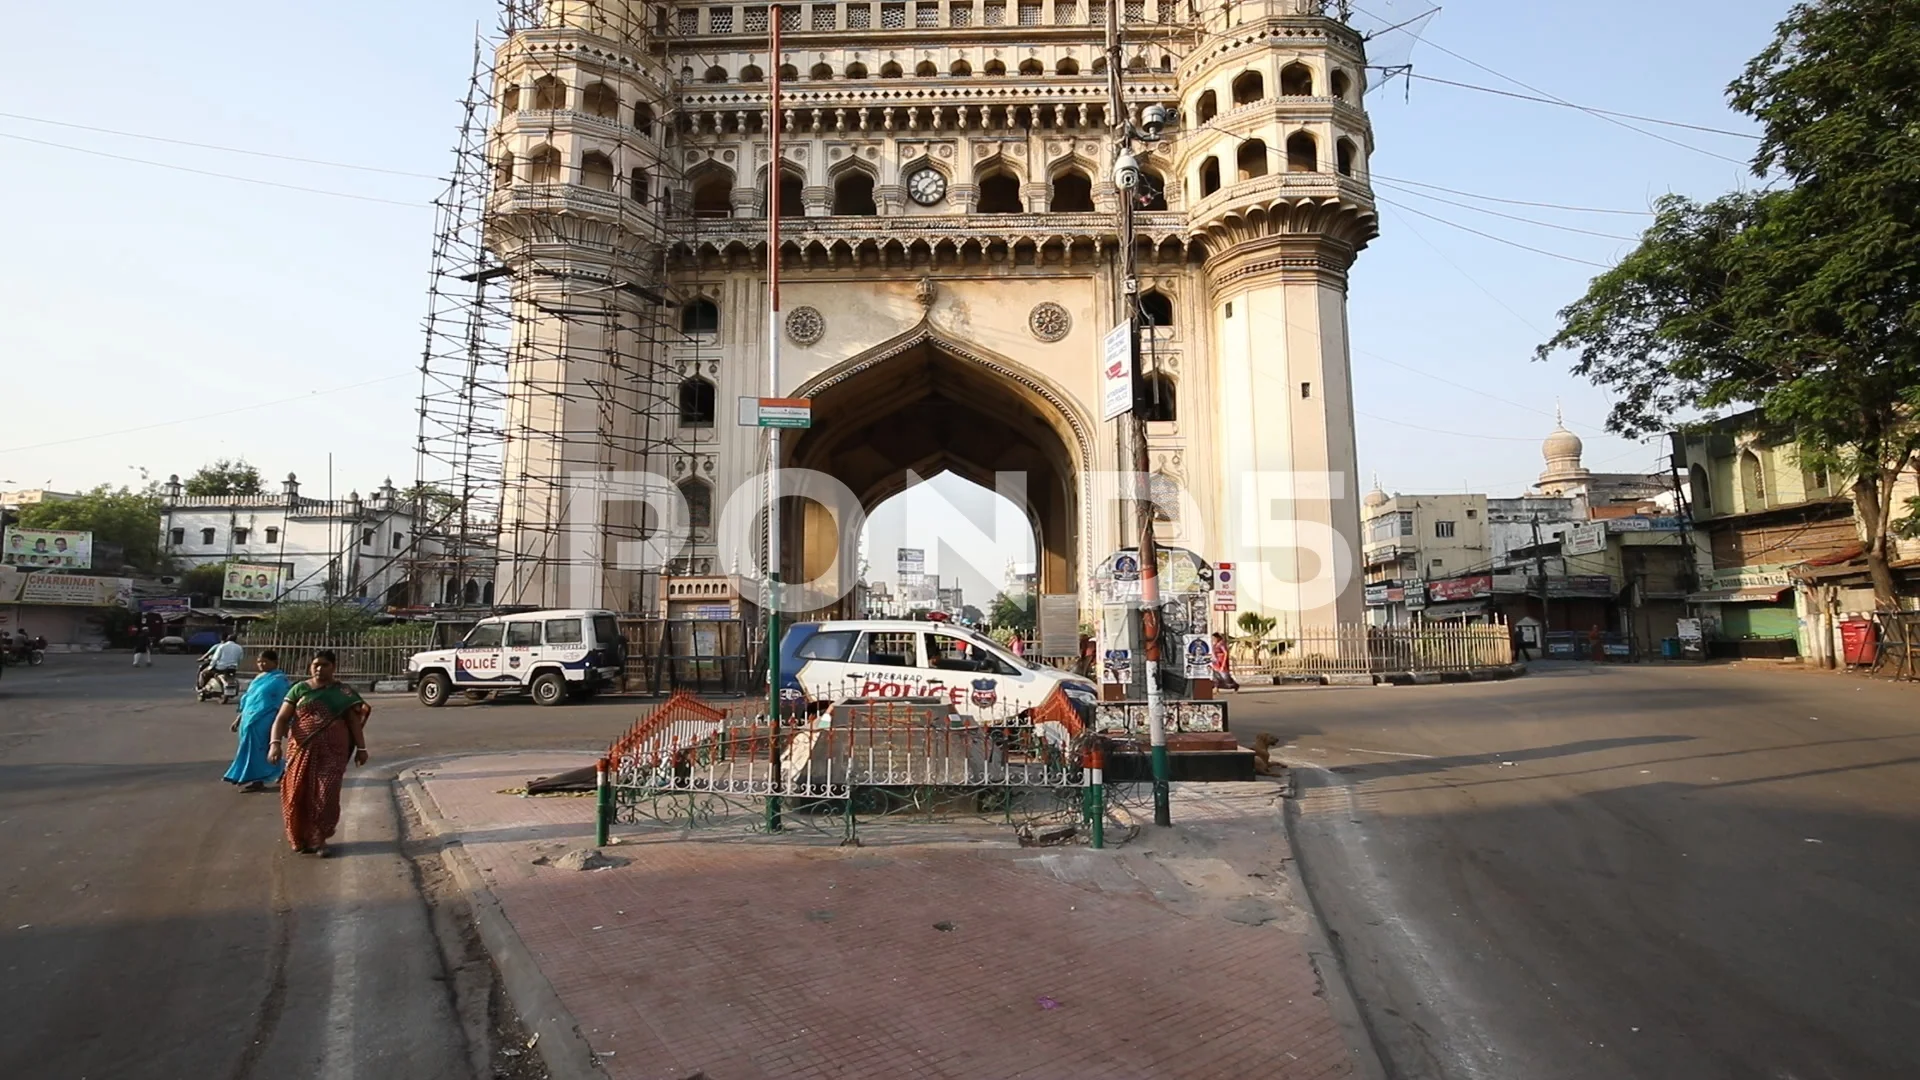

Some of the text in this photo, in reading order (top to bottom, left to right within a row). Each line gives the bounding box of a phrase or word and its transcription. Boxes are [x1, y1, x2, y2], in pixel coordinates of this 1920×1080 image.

[28, 575, 97, 587] CHARMINAR
[457, 658, 497, 669] POLICE
[863, 671, 923, 681] HYDERABAD
[861, 681, 967, 705] POLICE
